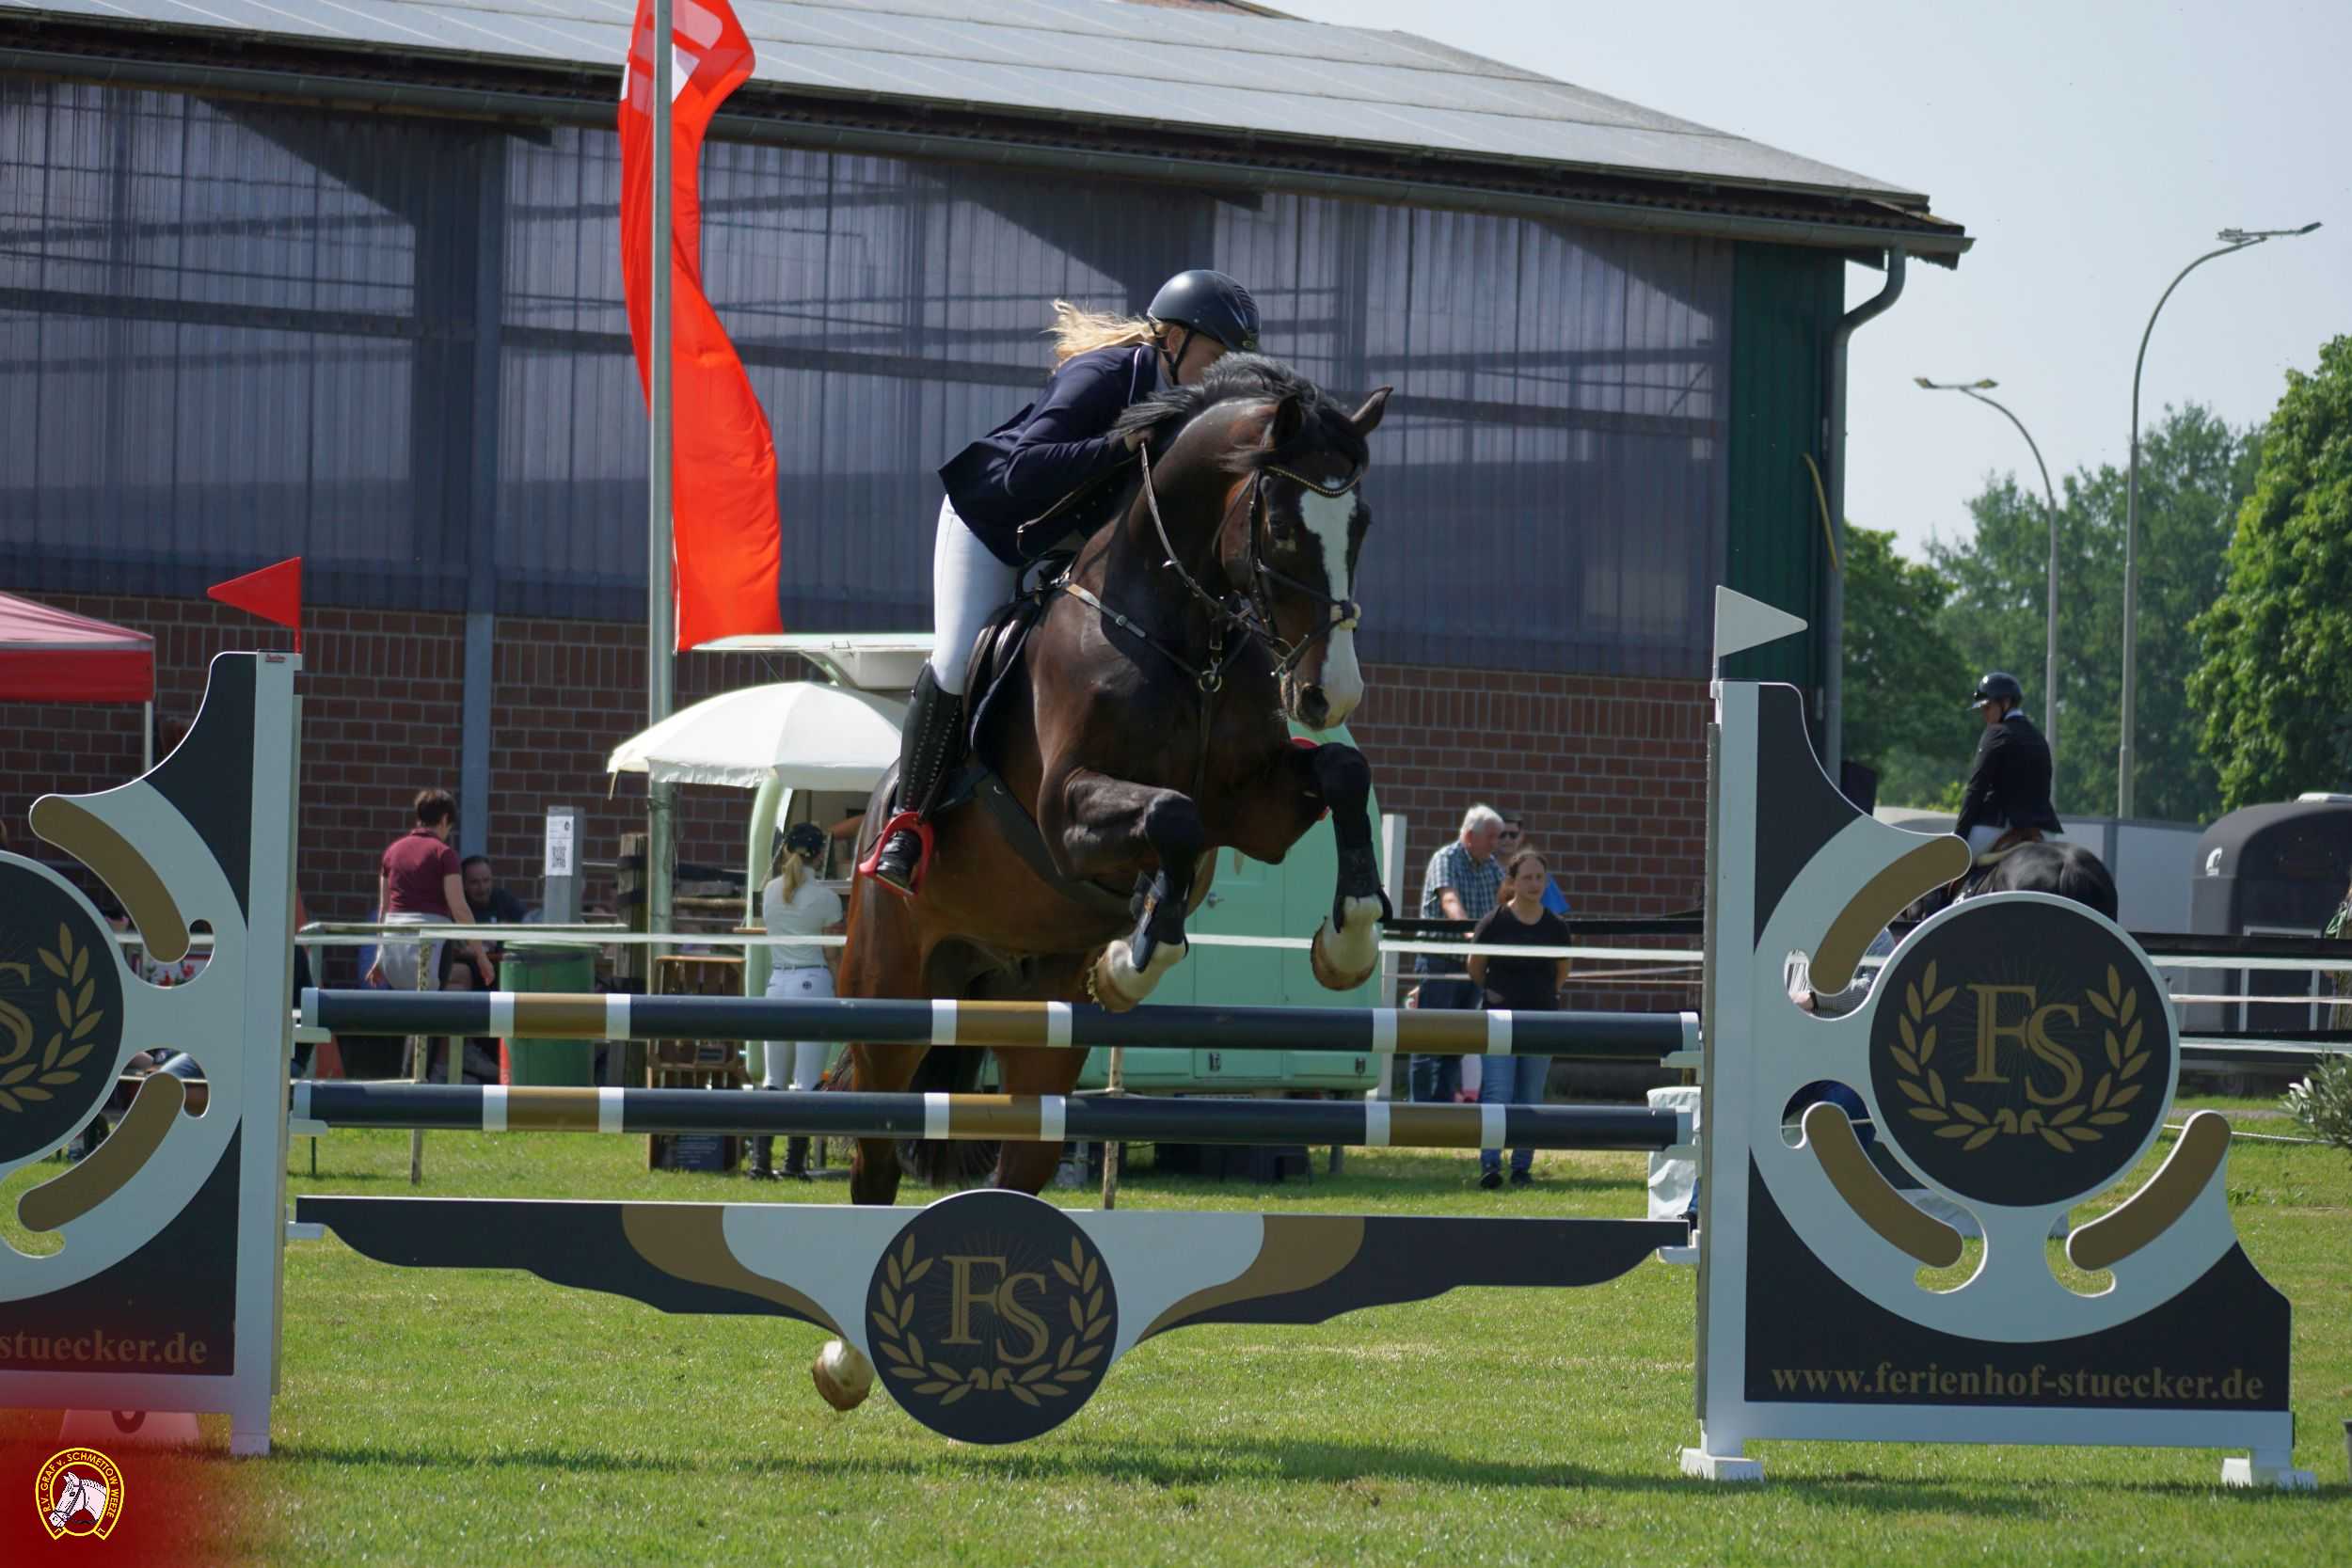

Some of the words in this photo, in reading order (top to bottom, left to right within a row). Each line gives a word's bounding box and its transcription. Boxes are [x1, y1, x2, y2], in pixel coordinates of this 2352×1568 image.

[1964, 983, 2084, 1105] FS
[941, 1255, 1049, 1365] FS
[1772, 1361, 2265, 1401] www.ferienhof-stuecker.de
